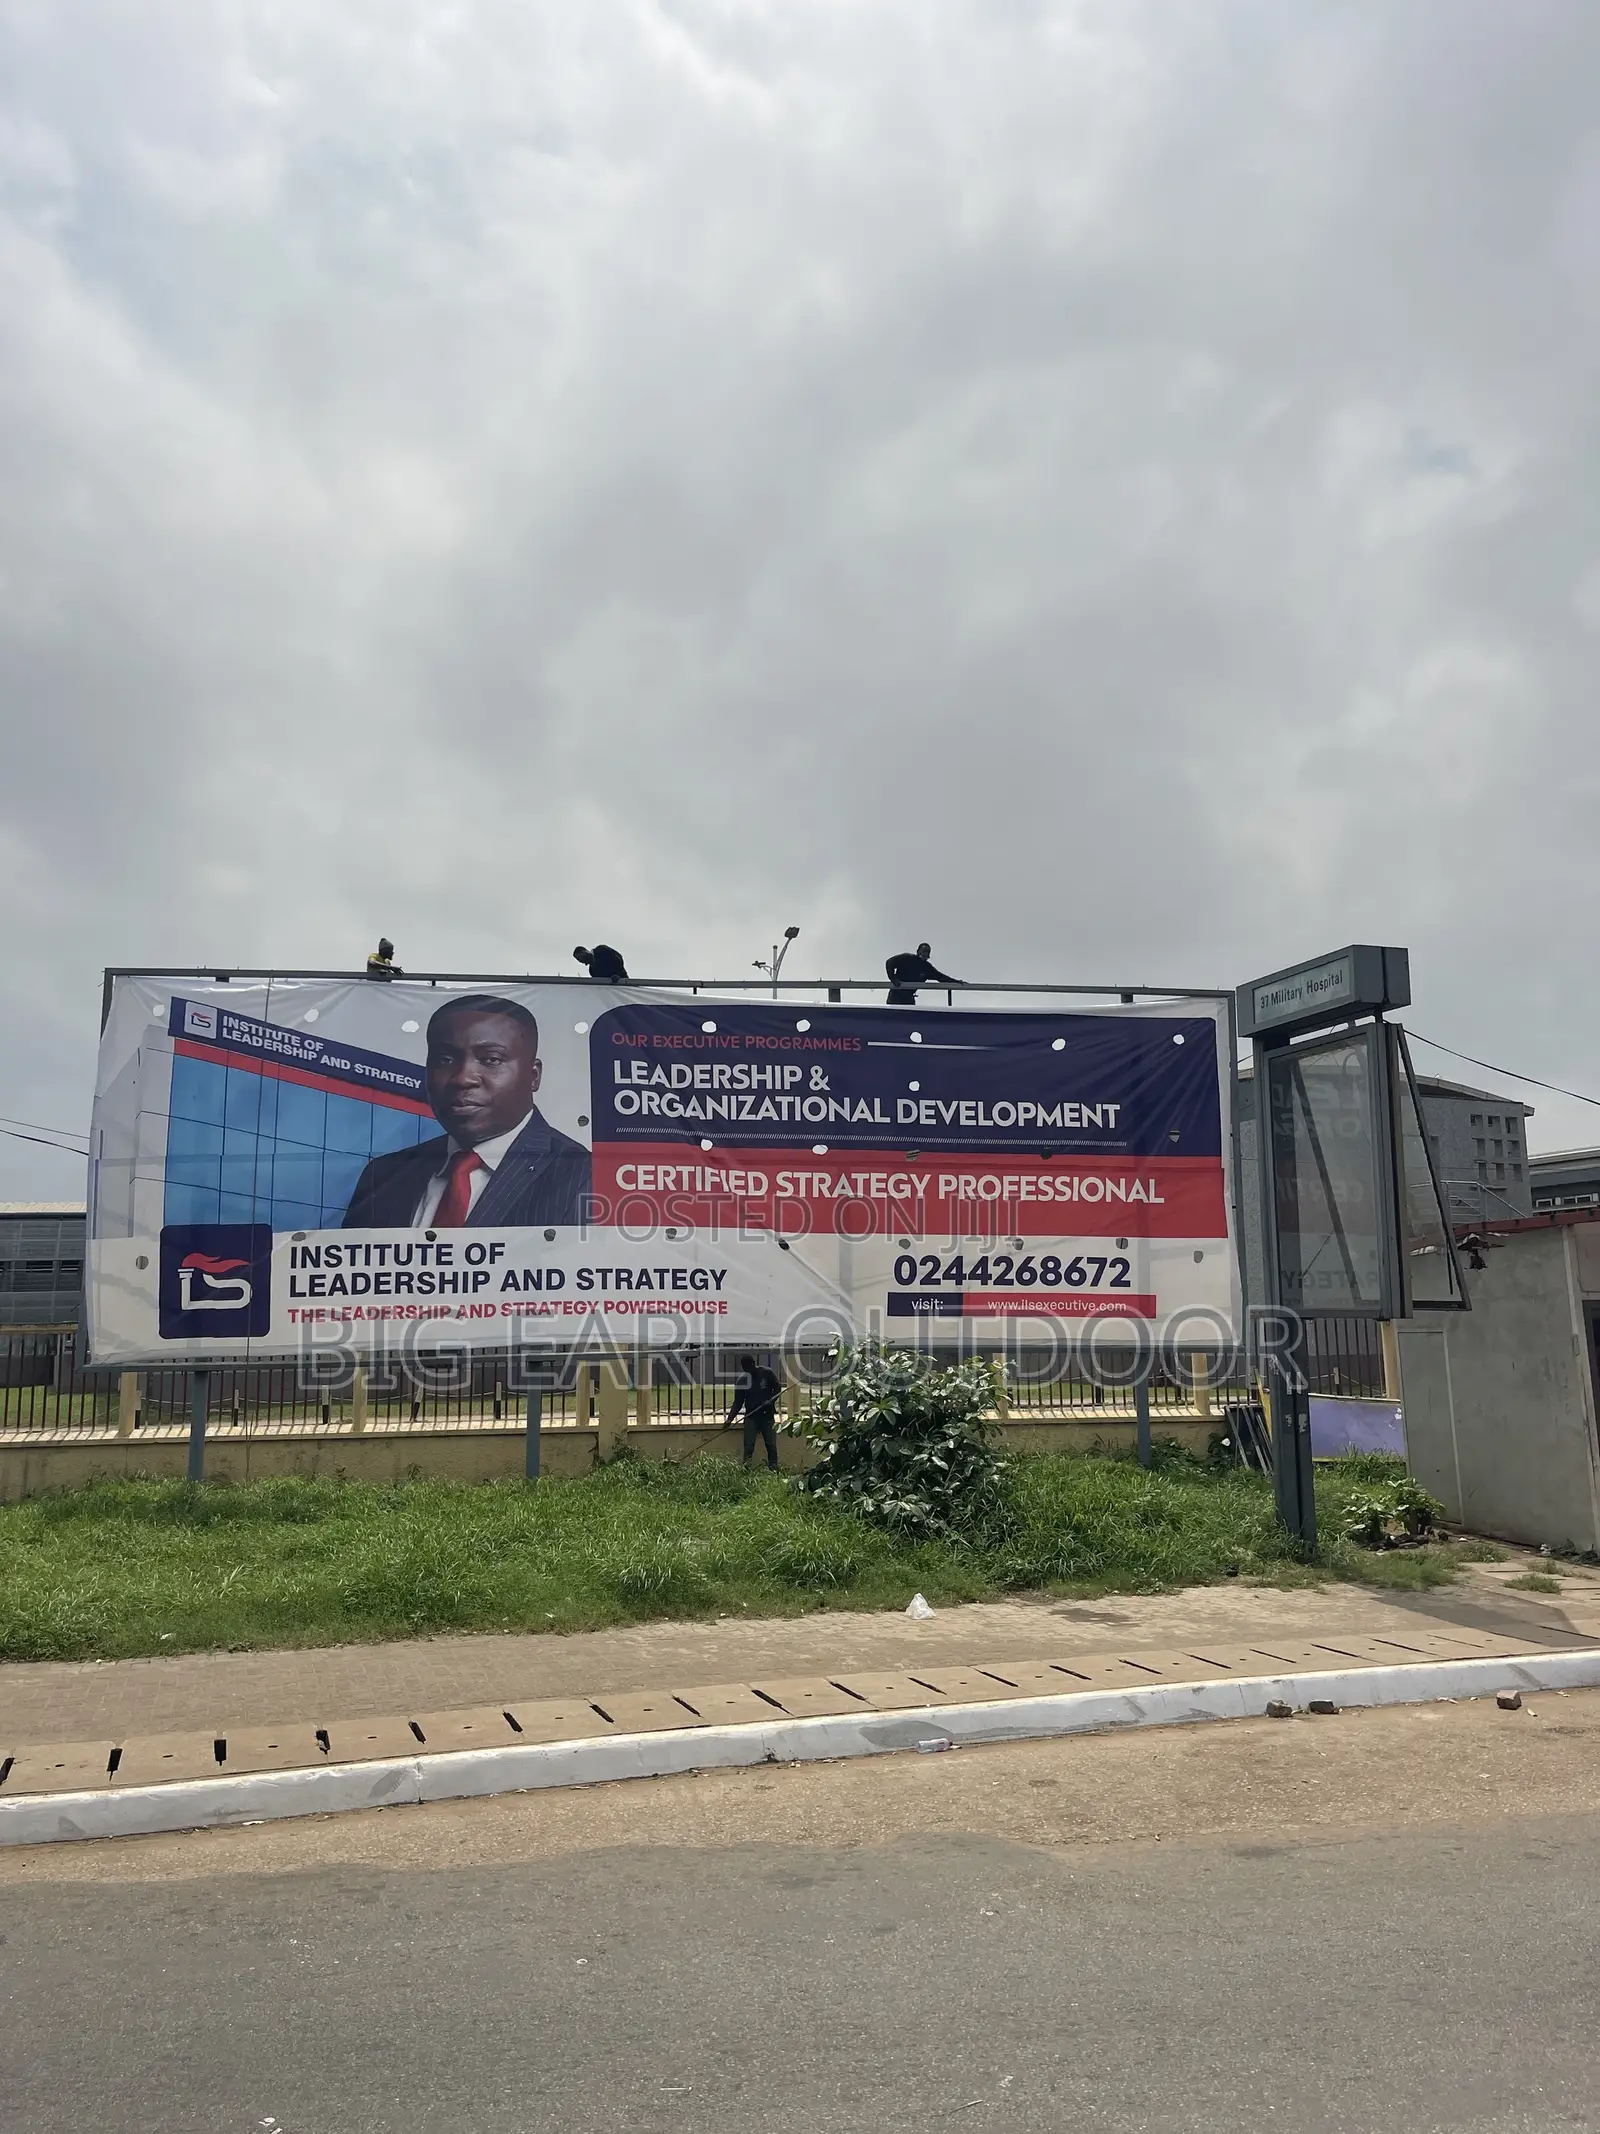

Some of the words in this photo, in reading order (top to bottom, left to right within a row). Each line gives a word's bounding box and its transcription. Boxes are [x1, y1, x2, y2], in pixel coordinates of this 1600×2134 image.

[1260, 995, 1269, 1009] 37
[1271, 984, 1302, 1006] Military
[1306, 970, 1343, 994] Hospital
[222, 1015, 301, 1046] INSTITUTE
[304, 1038, 324, 1052] OF
[612, 1032, 648, 1048] OUR
[652, 1034, 740, 1049] EXECUTIVE
[745, 1036, 862, 1051] PROGRAMMES
[222, 1027, 317, 1061] LEADERSHIP
[320, 1054, 351, 1070] AND
[354, 1063, 422, 1089] STRATEGY
[613, 1059, 803, 1090] LEADERSHIP
[808, 1065, 831, 1091] &
[613, 1089, 891, 1123] ORGANIZATIONAL
[897, 1098, 1121, 1129] DEVELOPMENT
[615, 1164, 768, 1196] CERTIFIED
[775, 1171, 931, 1199] STRATEGY
[939, 1174, 1165, 1204] PROFESSIONAL
[290, 1243, 453, 1269] INSTITUTE
[464, 1242, 505, 1266] OF
[894, 1254, 1131, 1288] 0244268672
[289, 1270, 491, 1298] LEADERSHIP
[500, 1268, 566, 1292] AND
[576, 1267, 727, 1291] STRATEGY
[287, 1308, 326, 1324] THE
[331, 1304, 451, 1321] LEADERSHIP
[455, 1303, 497, 1319] AND
[501, 1301, 599, 1317] STRATEGY
[604, 1300, 728, 1315] POWERHOUSE
[911, 1298, 944, 1311] visit:
[987, 1299, 1127, 1312] www.ilsexecutive.com
